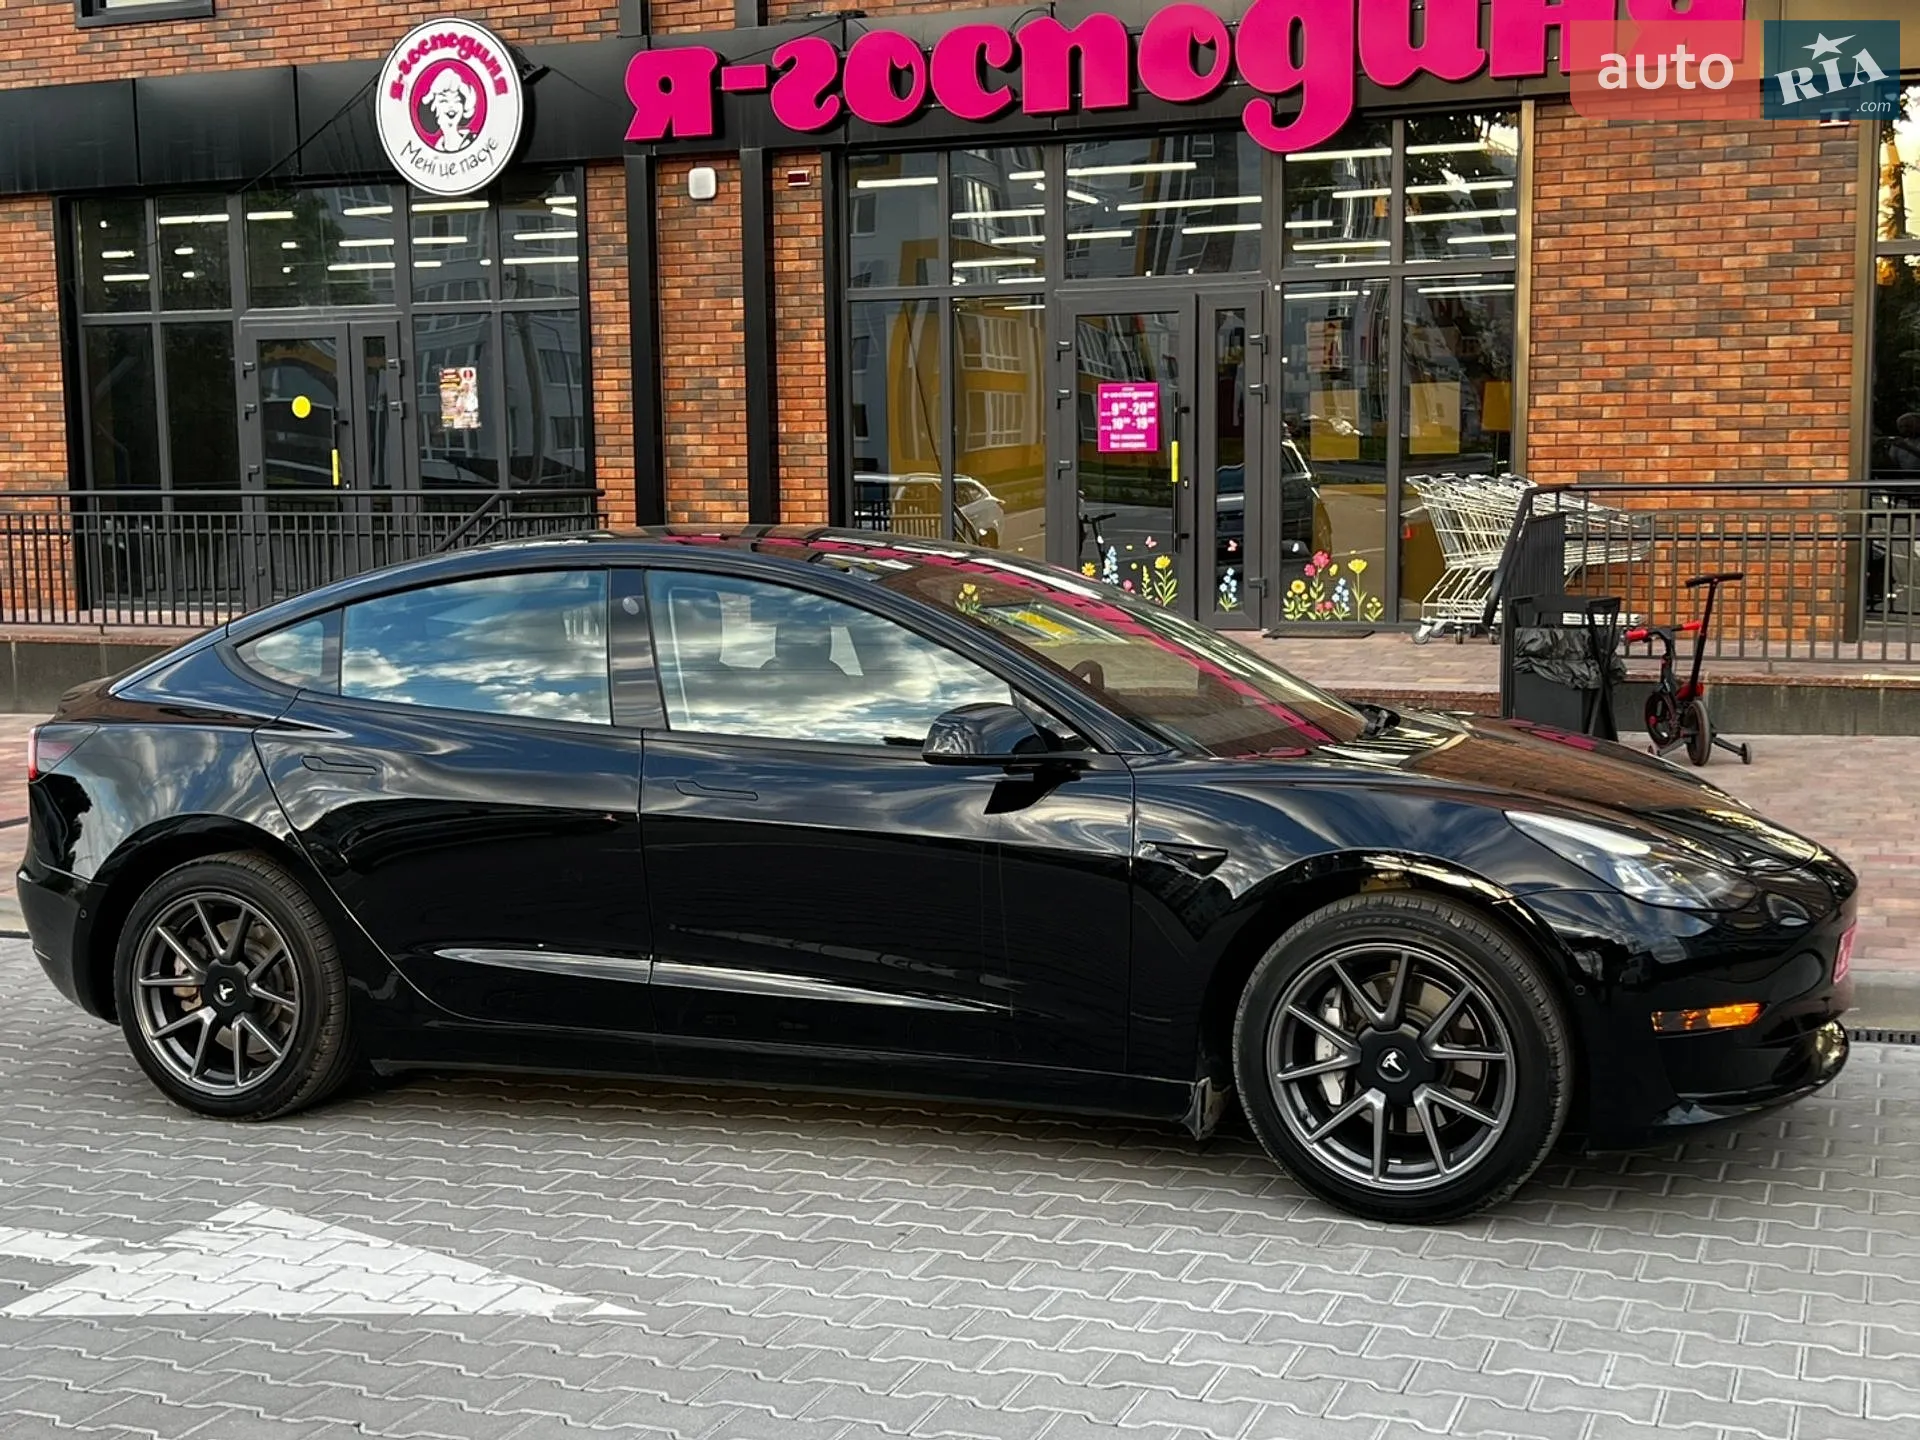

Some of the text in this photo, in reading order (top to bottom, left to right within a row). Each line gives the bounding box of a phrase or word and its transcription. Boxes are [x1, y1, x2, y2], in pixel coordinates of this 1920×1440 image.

[400, 137, 499, 177] Мені це пасує
